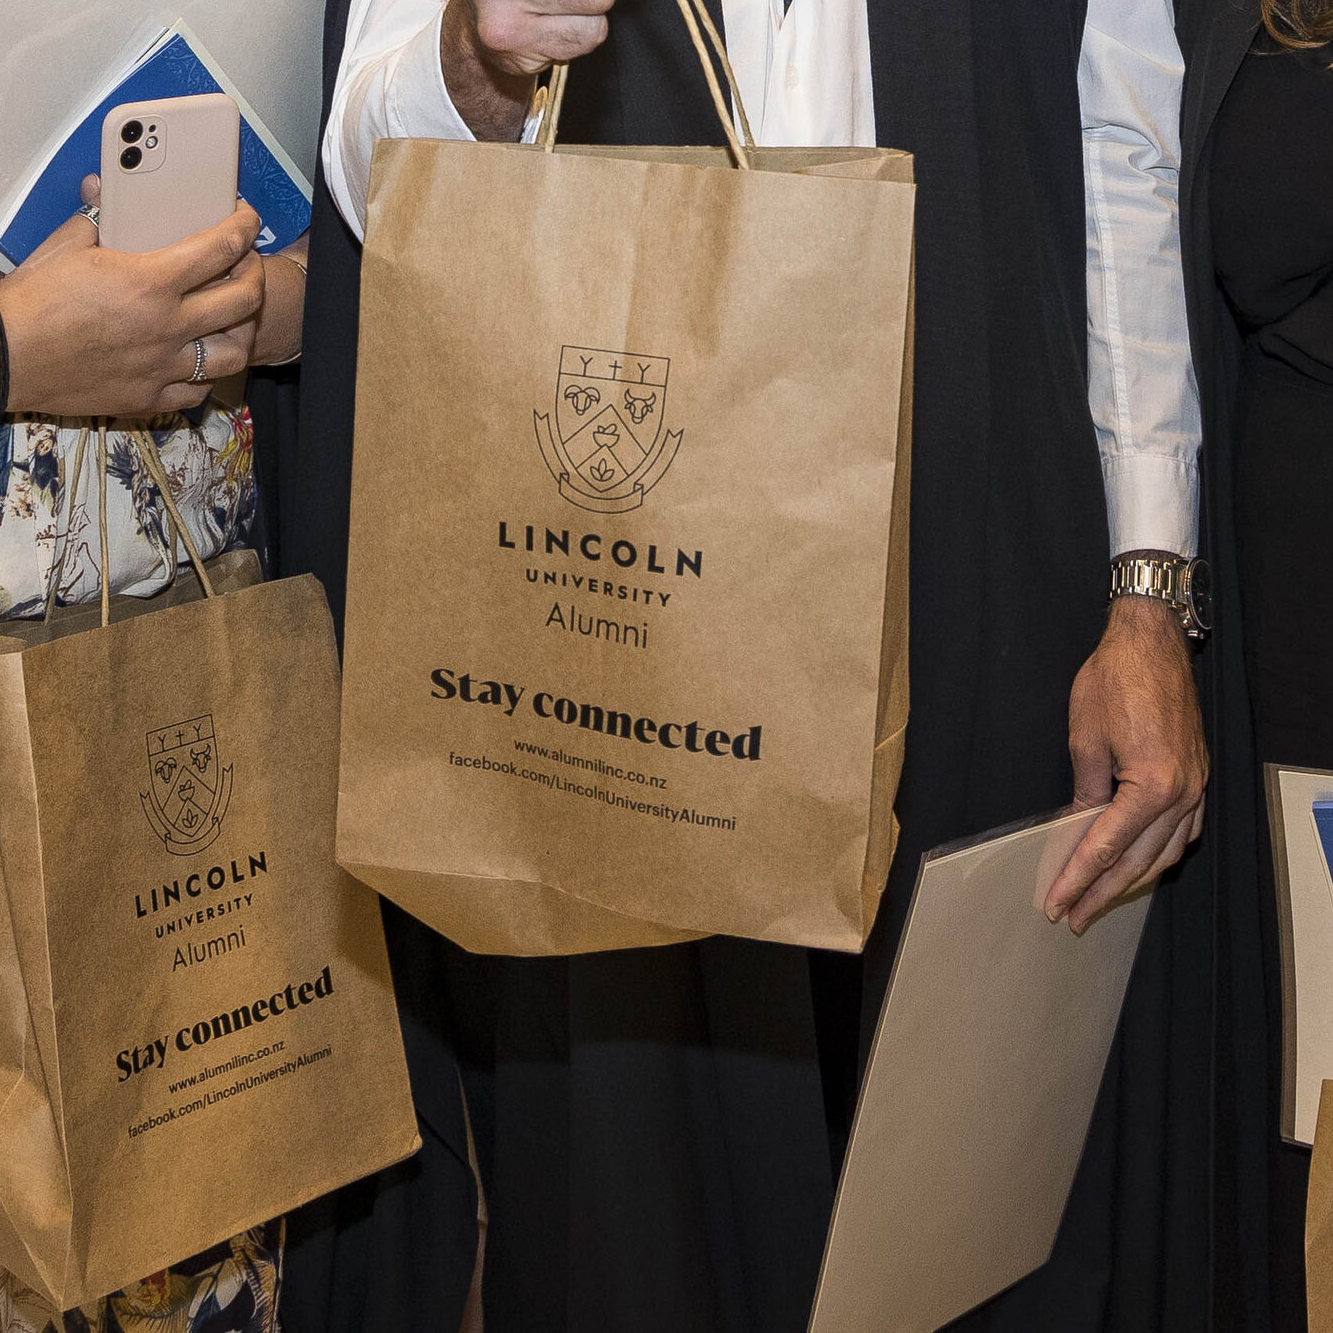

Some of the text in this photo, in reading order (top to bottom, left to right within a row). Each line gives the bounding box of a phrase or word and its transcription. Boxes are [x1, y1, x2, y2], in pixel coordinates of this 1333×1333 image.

[498, 521, 703, 579] LINCOLN
[525, 568, 672, 608] UNIVERSITY
[545, 602, 648, 649] Alumni
[430, 668, 763, 762] Stay connected
[448, 751, 737, 831] facebook.com/LincolnUniversityAlumni
[513, 740, 668, 790] www.alumnilinc.co.nz
[134, 851, 268, 919] LINCOLN
[154, 893, 253, 939] UNIVERSITY
[172, 924, 246, 972] Alumni
[116, 965, 335, 1083] Stay connected
[127, 1044, 333, 1139] facebook.com/LincolnUniversityAlumni
[168, 1040, 286, 1094] www.alumnilinc.co.nz
